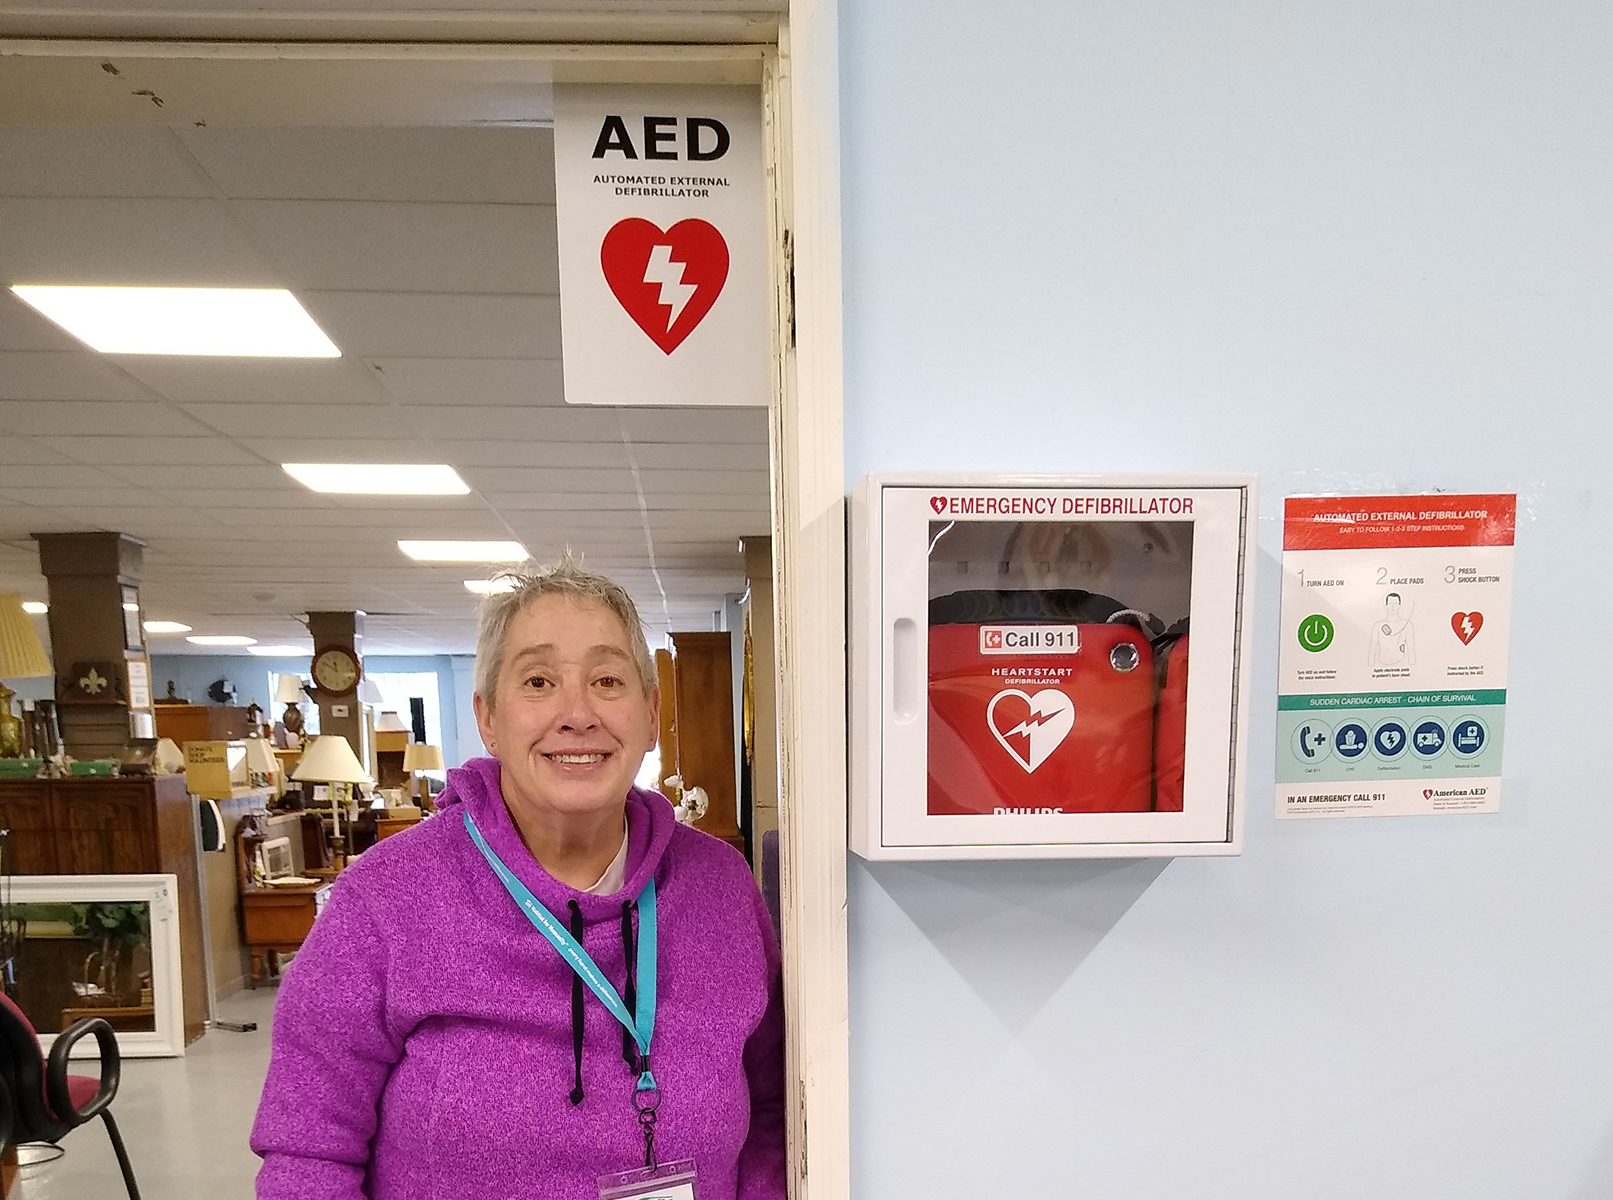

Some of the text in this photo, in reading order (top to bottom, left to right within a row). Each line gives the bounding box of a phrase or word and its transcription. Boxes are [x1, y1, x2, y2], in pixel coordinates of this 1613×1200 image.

[592, 115, 730, 161] AED
[593, 174, 730, 186] AUTOMATED EXTERNAL
[615, 187, 710, 198] DEFIBRILLATOR
[950, 498, 1194, 514] EMERGENCY DEFIBRILLATOR
[1313, 510, 1488, 522] AUTOMATED EXTERNAL DEFIBRILLATOR
[1296, 568, 1304, 587] 1
[1376, 566, 1388, 585] 2
[1444, 565, 1456, 584] 3
[1006, 632, 1074, 647] Call 911
[1309, 794, 1352, 802] EMERGENCY
